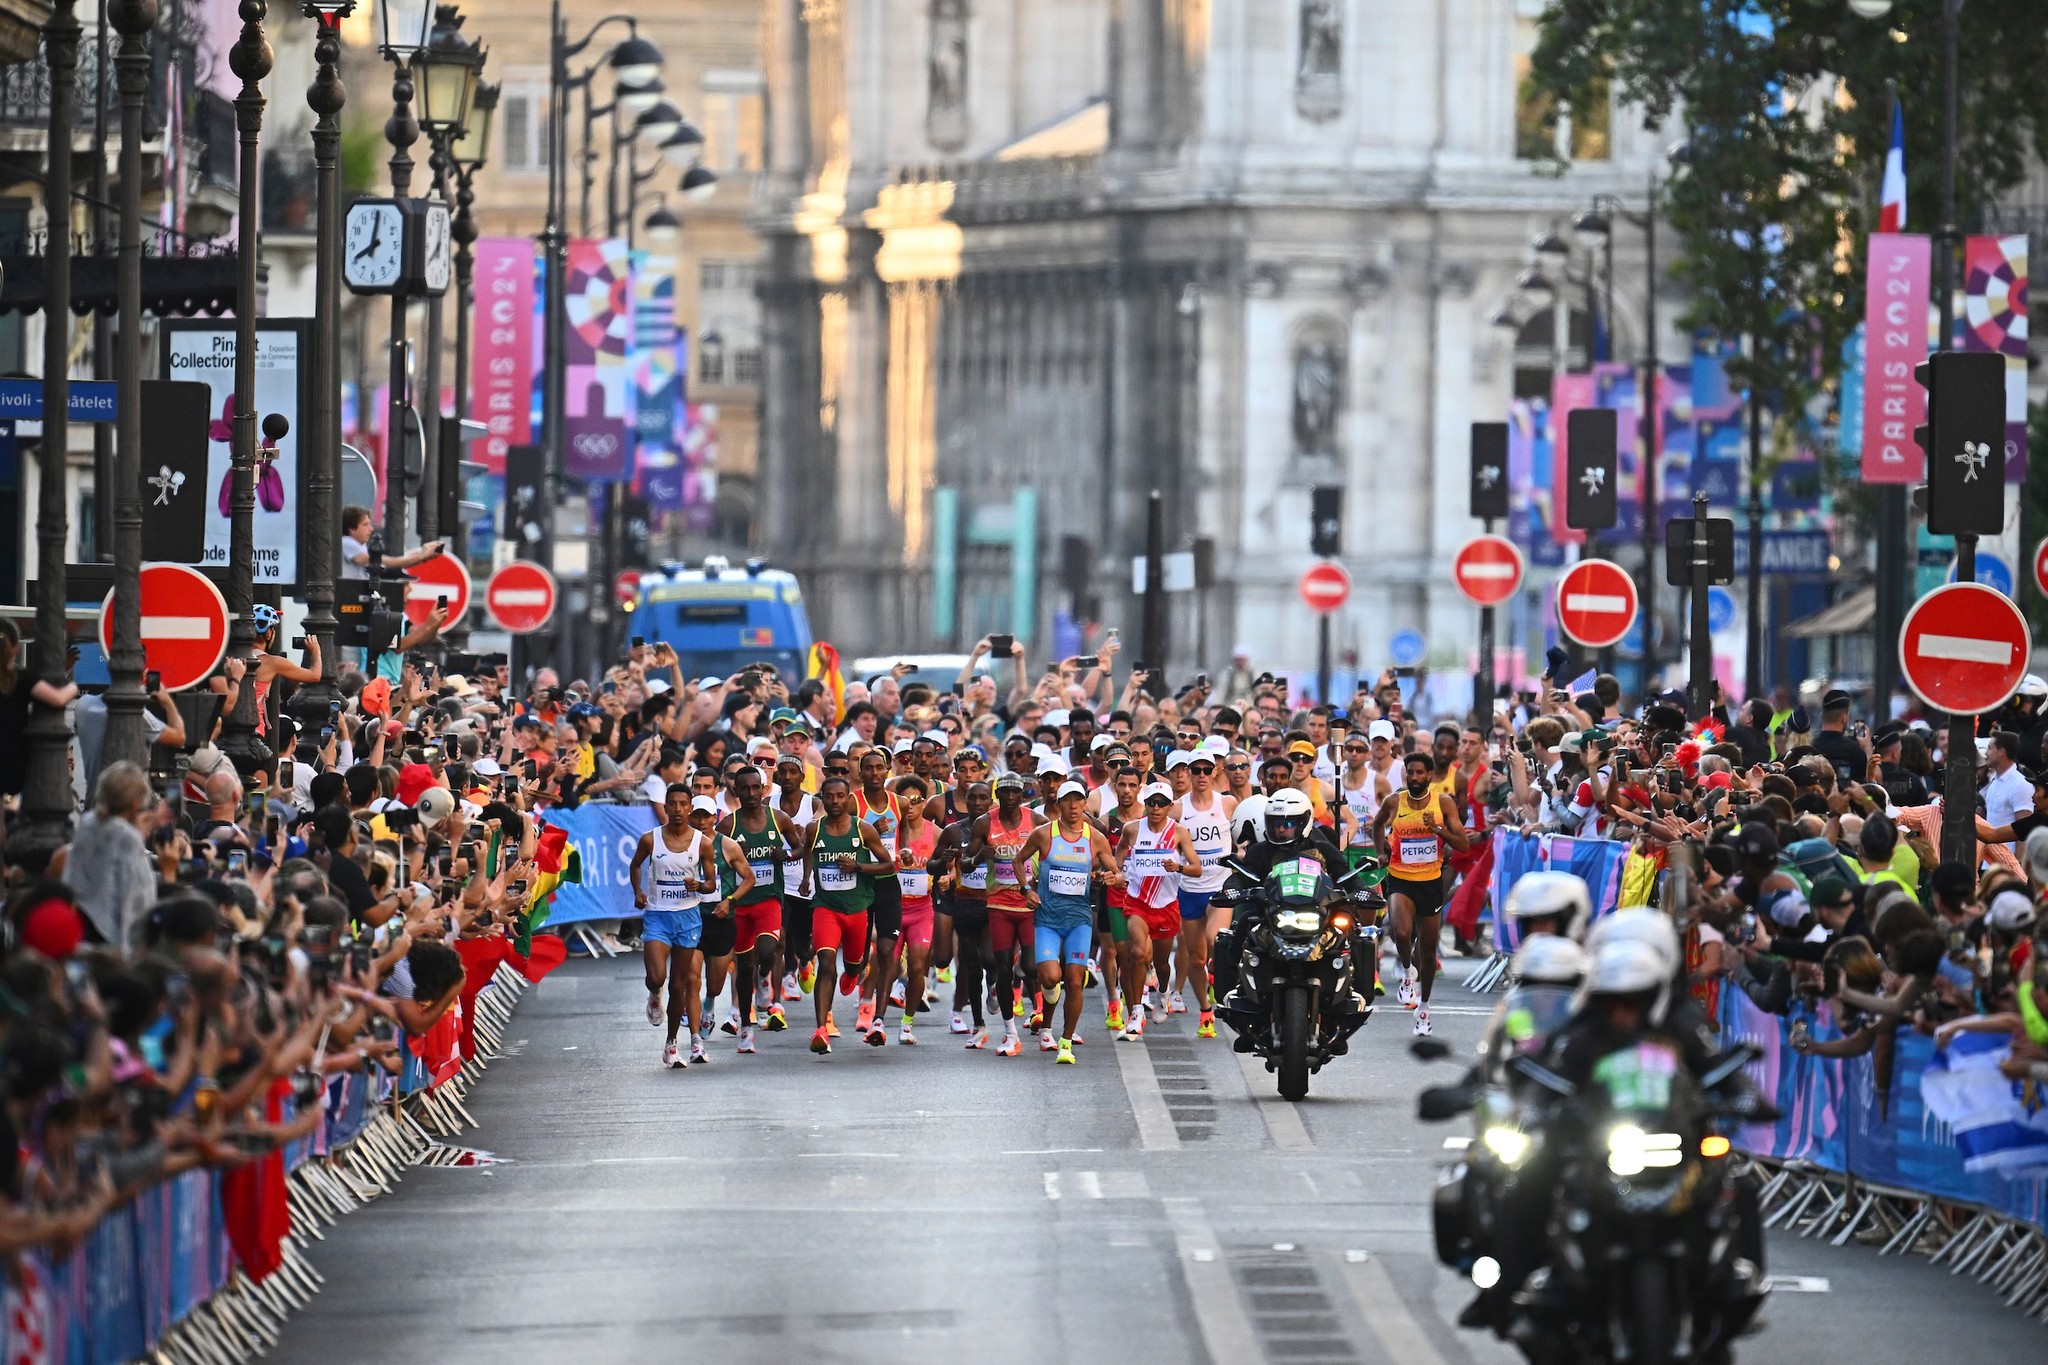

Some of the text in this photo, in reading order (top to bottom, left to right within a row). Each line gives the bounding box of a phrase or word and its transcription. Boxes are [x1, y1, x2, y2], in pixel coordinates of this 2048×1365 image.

[1885, 255, 1911, 348] 2024
[213, 337, 259, 351] Pint
[1, 393, 31, 406] ivoli
[68, 395, 113, 409] âtelet
[1734, 537, 1824, 568] CANGE
[264, 566, 279, 577] va
[1188, 826, 1221, 842] USA
[995, 844, 1024, 858] KENY
[1402, 845, 1437, 856] PETROS
[756, 869, 772, 878] ETA
[821, 873, 854, 882] BEKELE
[903, 879, 915, 887] HE
[661, 890, 690, 899] FANIEL
